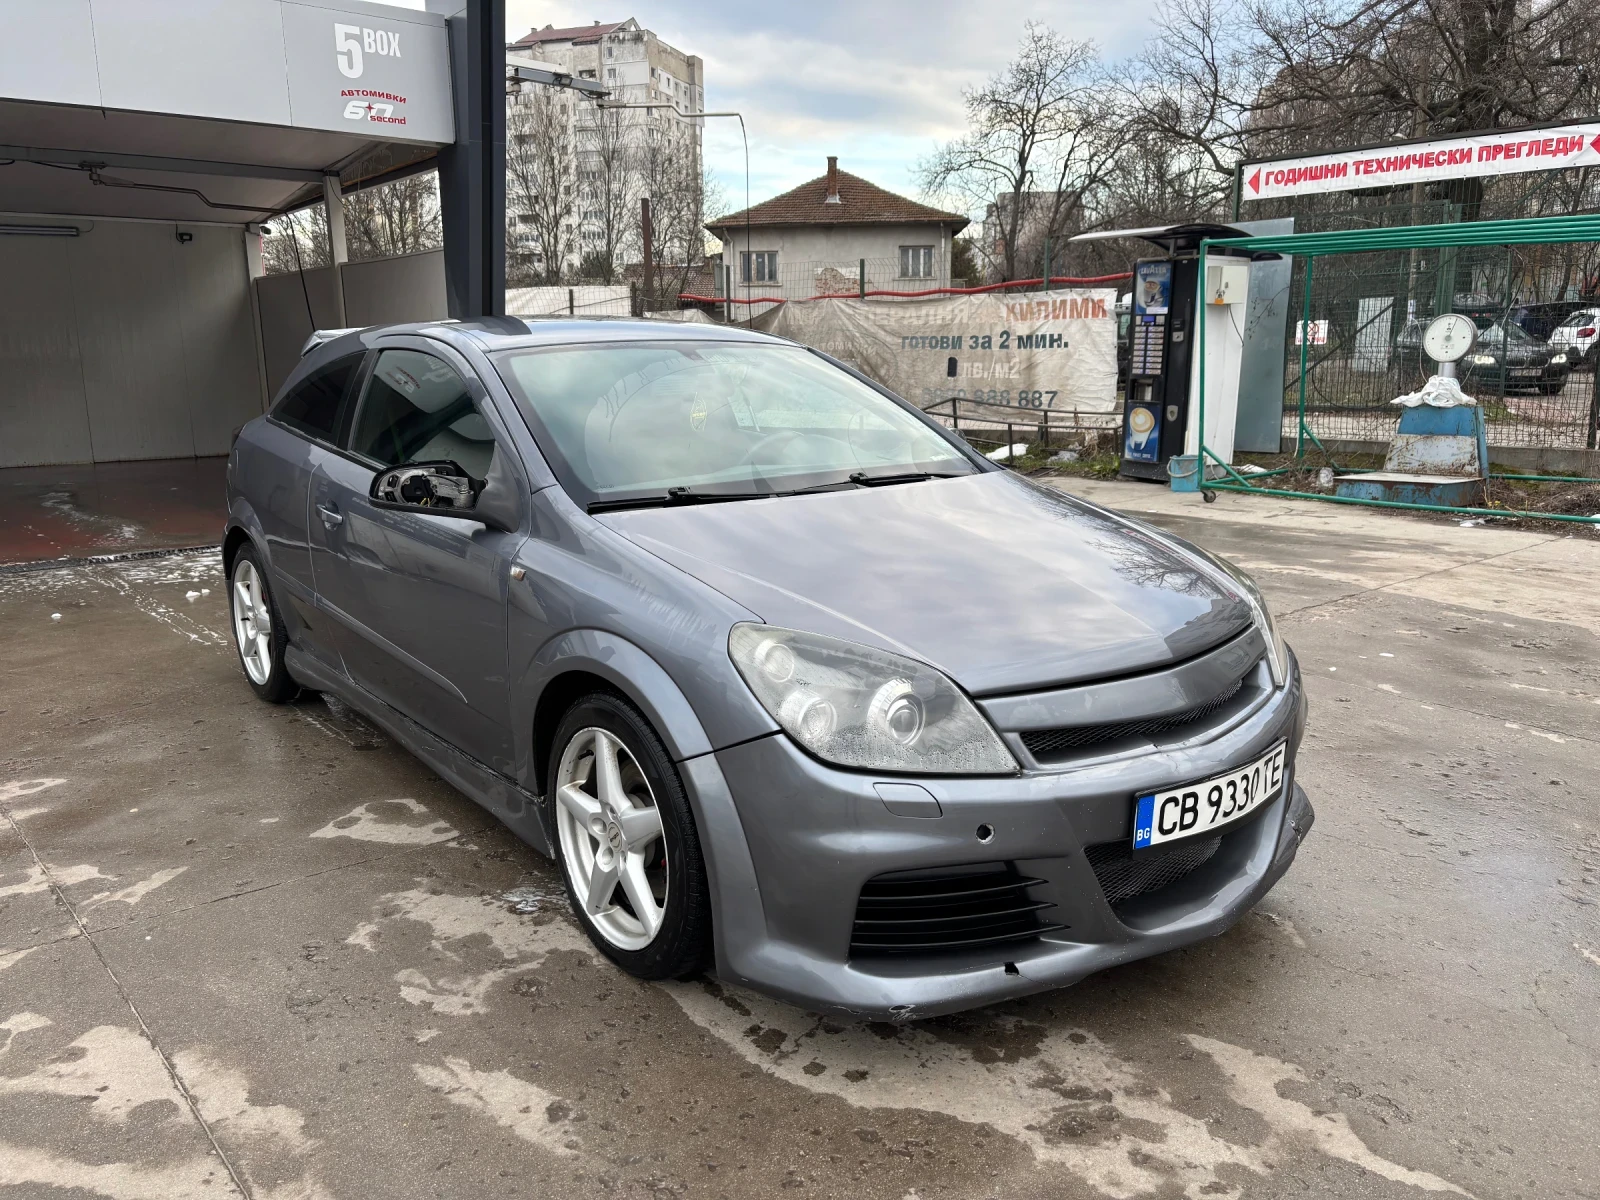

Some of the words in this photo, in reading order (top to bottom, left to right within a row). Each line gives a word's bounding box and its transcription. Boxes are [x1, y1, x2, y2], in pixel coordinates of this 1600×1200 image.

[334, 23, 364, 79] 5
[363, 28, 401, 58] BOX
[340, 89, 407, 104] АВТОМИВКИ
[370, 114, 406, 125] second
[1264, 162, 1348, 187] ГОДИШНИ
[1352, 148, 1473, 175] ТЕХНИЧЕСКИ
[1477, 134, 1584, 162] ПРЕГЛЕДИ
[901, 335, 962, 350] готови
[969, 335, 992, 350] за
[999, 330, 1011, 350] 2
[1017, 332, 1069, 349] мин.
[1018, 390, 1058, 409] 887
[1158, 791, 1199, 836] CB
[1207, 766, 1260, 825] 9330
[1263, 748, 1283, 795] TE
[1136, 827, 1151, 842] BG
